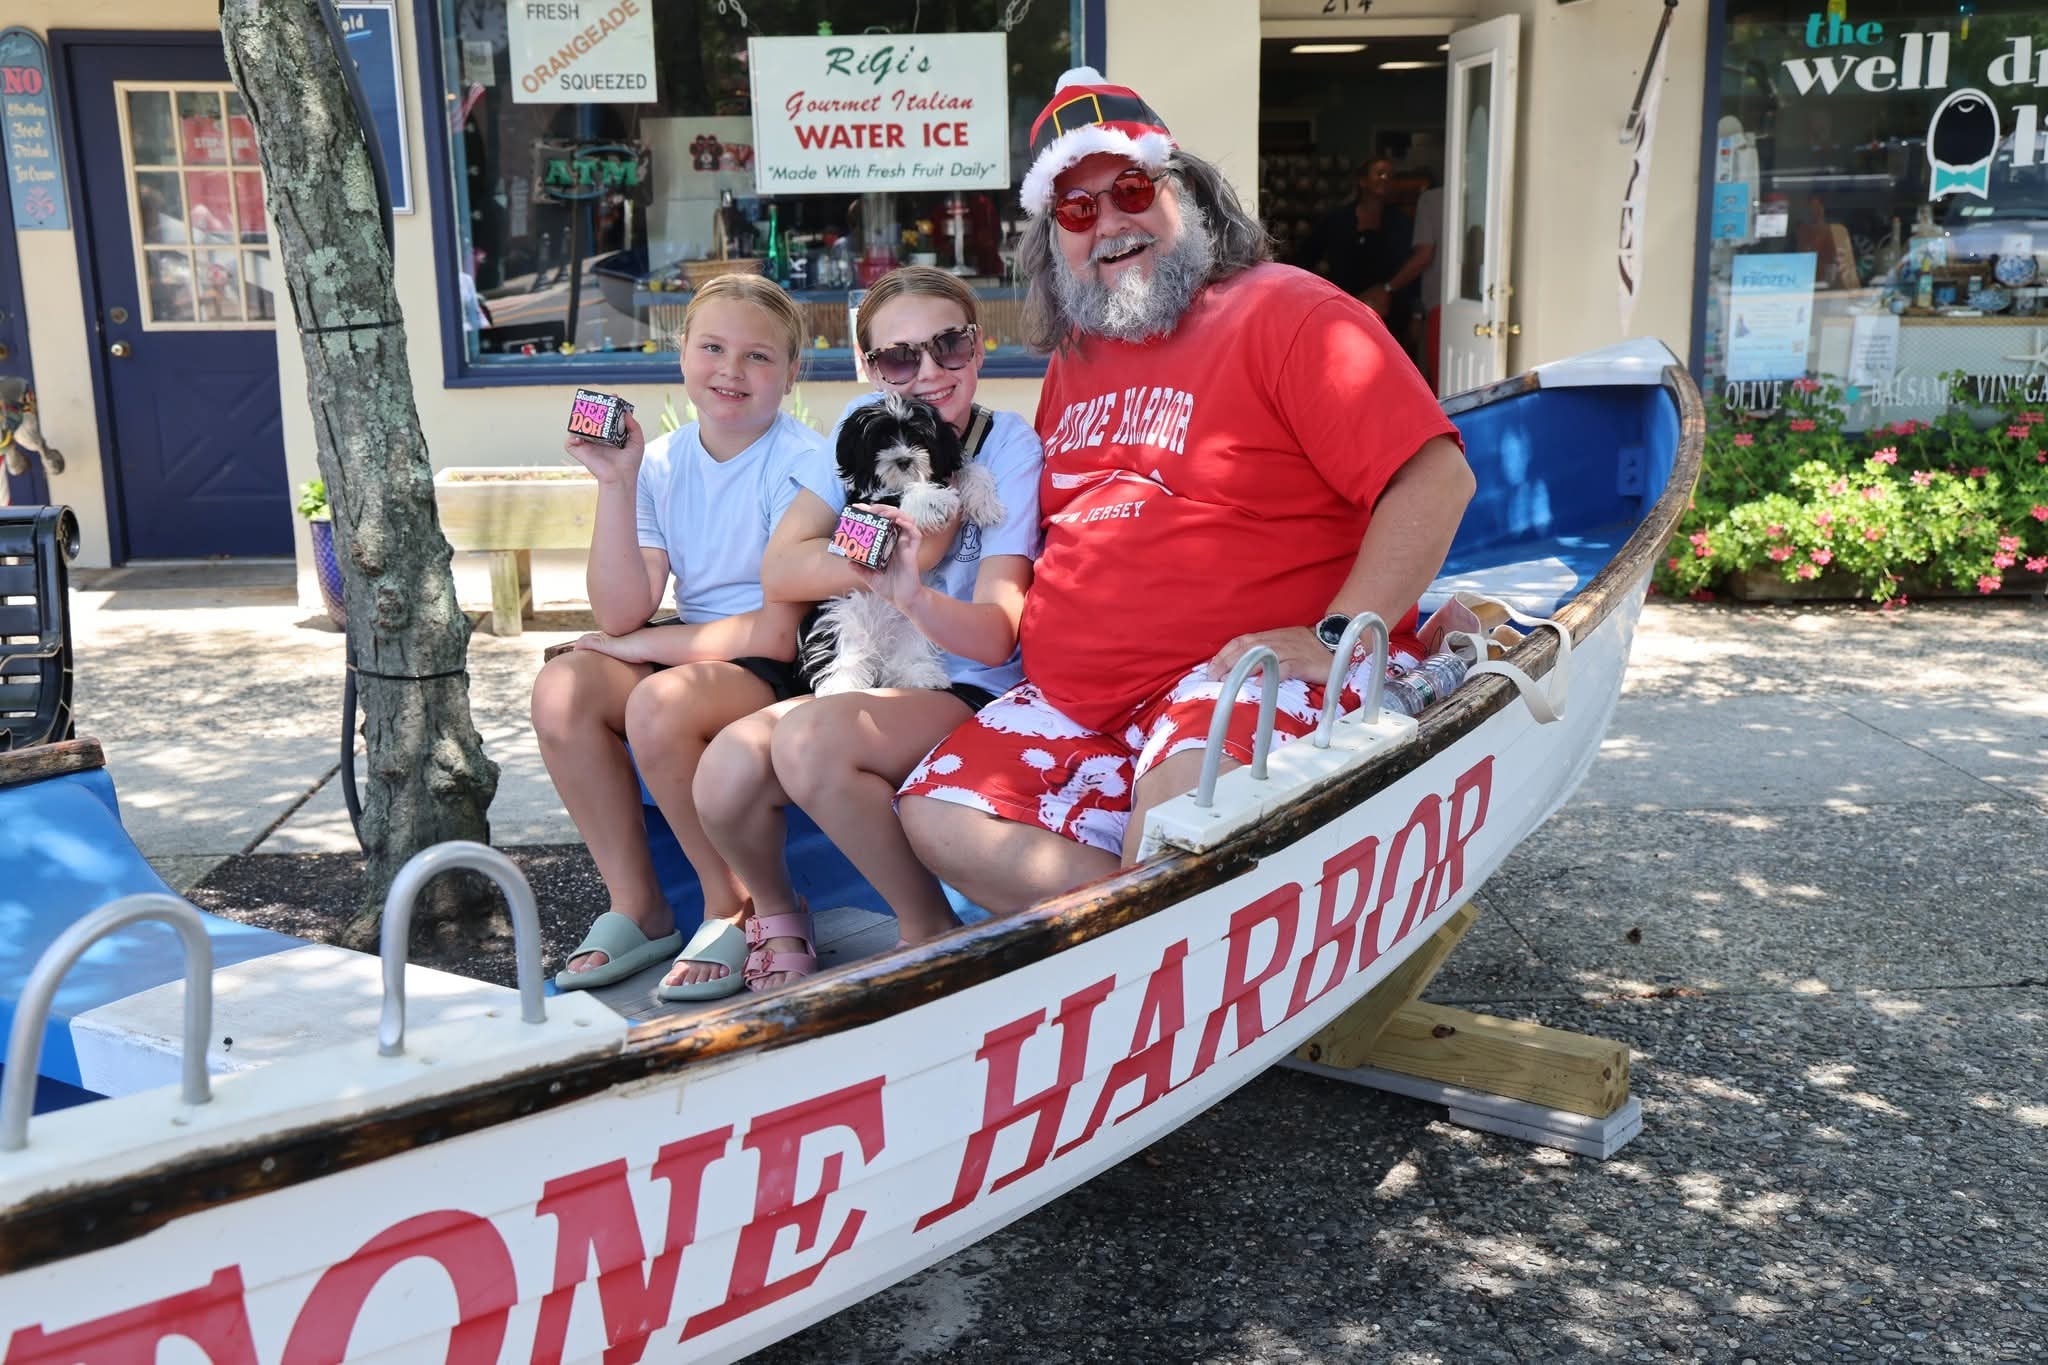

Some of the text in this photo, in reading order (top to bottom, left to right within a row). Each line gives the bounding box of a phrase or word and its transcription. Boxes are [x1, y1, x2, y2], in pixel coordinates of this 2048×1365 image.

[526, 4, 580, 20] FRESH
[1805, 12, 1884, 48] the
[521, 0, 640, 94] ORANGEADE
[825, 45, 932, 85] RiGi's
[1781, 31, 1951, 96] well
[1, 67, 43, 94] NO
[560, 73, 647, 91] SQUEEZED
[785, 89, 974, 120] Gourmet Italian
[794, 122, 968, 149] WATER ICE
[545, 159, 640, 186] ATM
[768, 161, 996, 181] "Made With Fresh Fruit Daily"
[1742, 272, 1797, 288] FROZEN
[1725, 379, 1783, 410] OLIVE
[569, 413, 603, 438] DOH
[573, 399, 609, 425] NEE
[1044, 385, 1194, 457] TONE HARBOR
[1082, 500, 1146, 524] JERSEY
[835, 516, 878, 549] NEE
[834, 532, 872, 563] DOH
[913, 754, 1496, 1234] HARBOR
